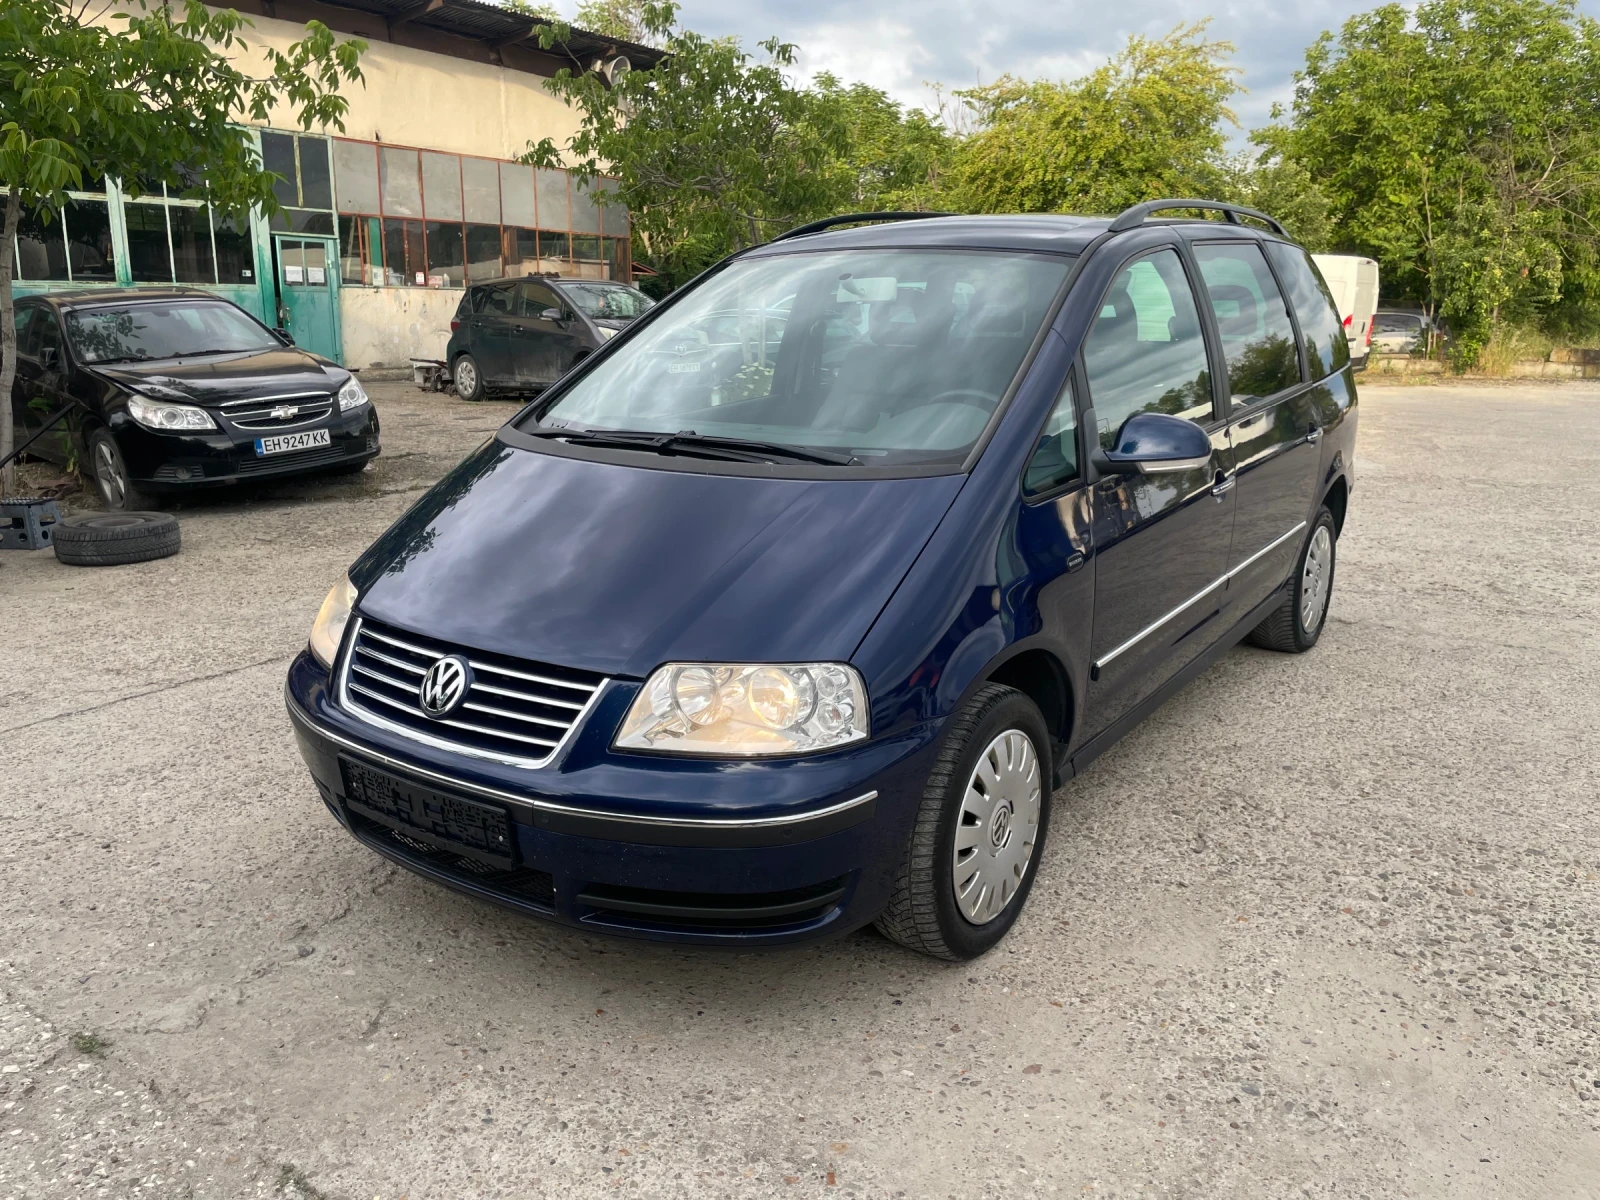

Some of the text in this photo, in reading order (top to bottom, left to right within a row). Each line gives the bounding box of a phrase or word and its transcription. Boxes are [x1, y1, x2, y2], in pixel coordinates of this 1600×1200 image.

[264, 431, 328, 451] EH 9247 KK
